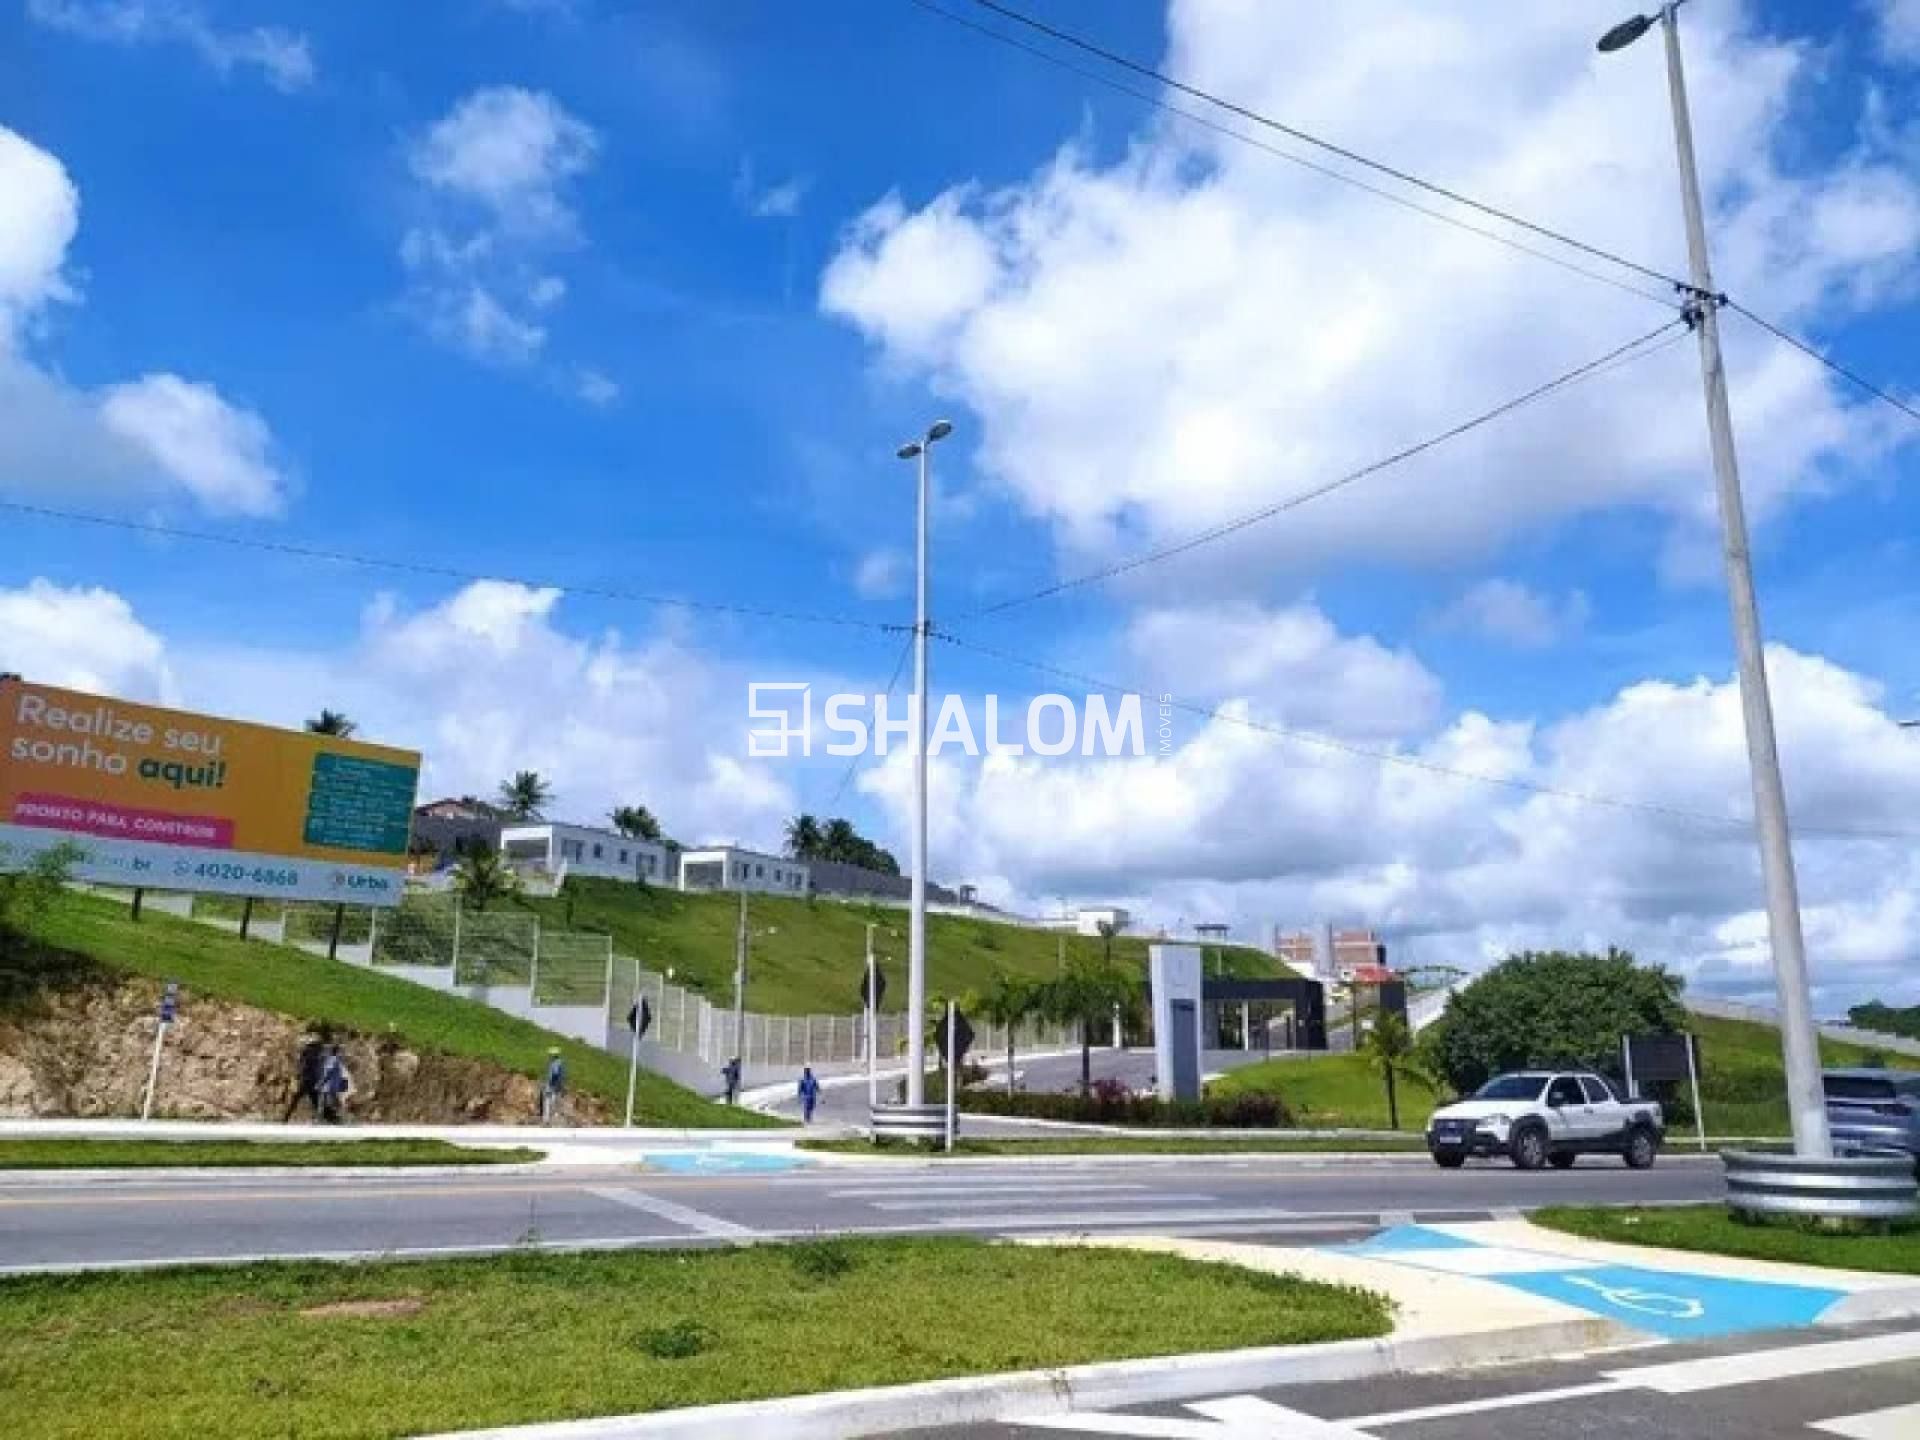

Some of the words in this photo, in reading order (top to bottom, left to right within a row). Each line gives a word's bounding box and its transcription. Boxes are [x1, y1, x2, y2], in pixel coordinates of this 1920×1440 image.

[17, 695, 154, 745] Realize
[164, 728, 221, 755] seu
[11, 737, 127, 775] sonho
[138, 758, 226, 790] aqui!
[15, 803, 83, 821] PRONTO
[194, 863, 299, 887] 4020-6868
